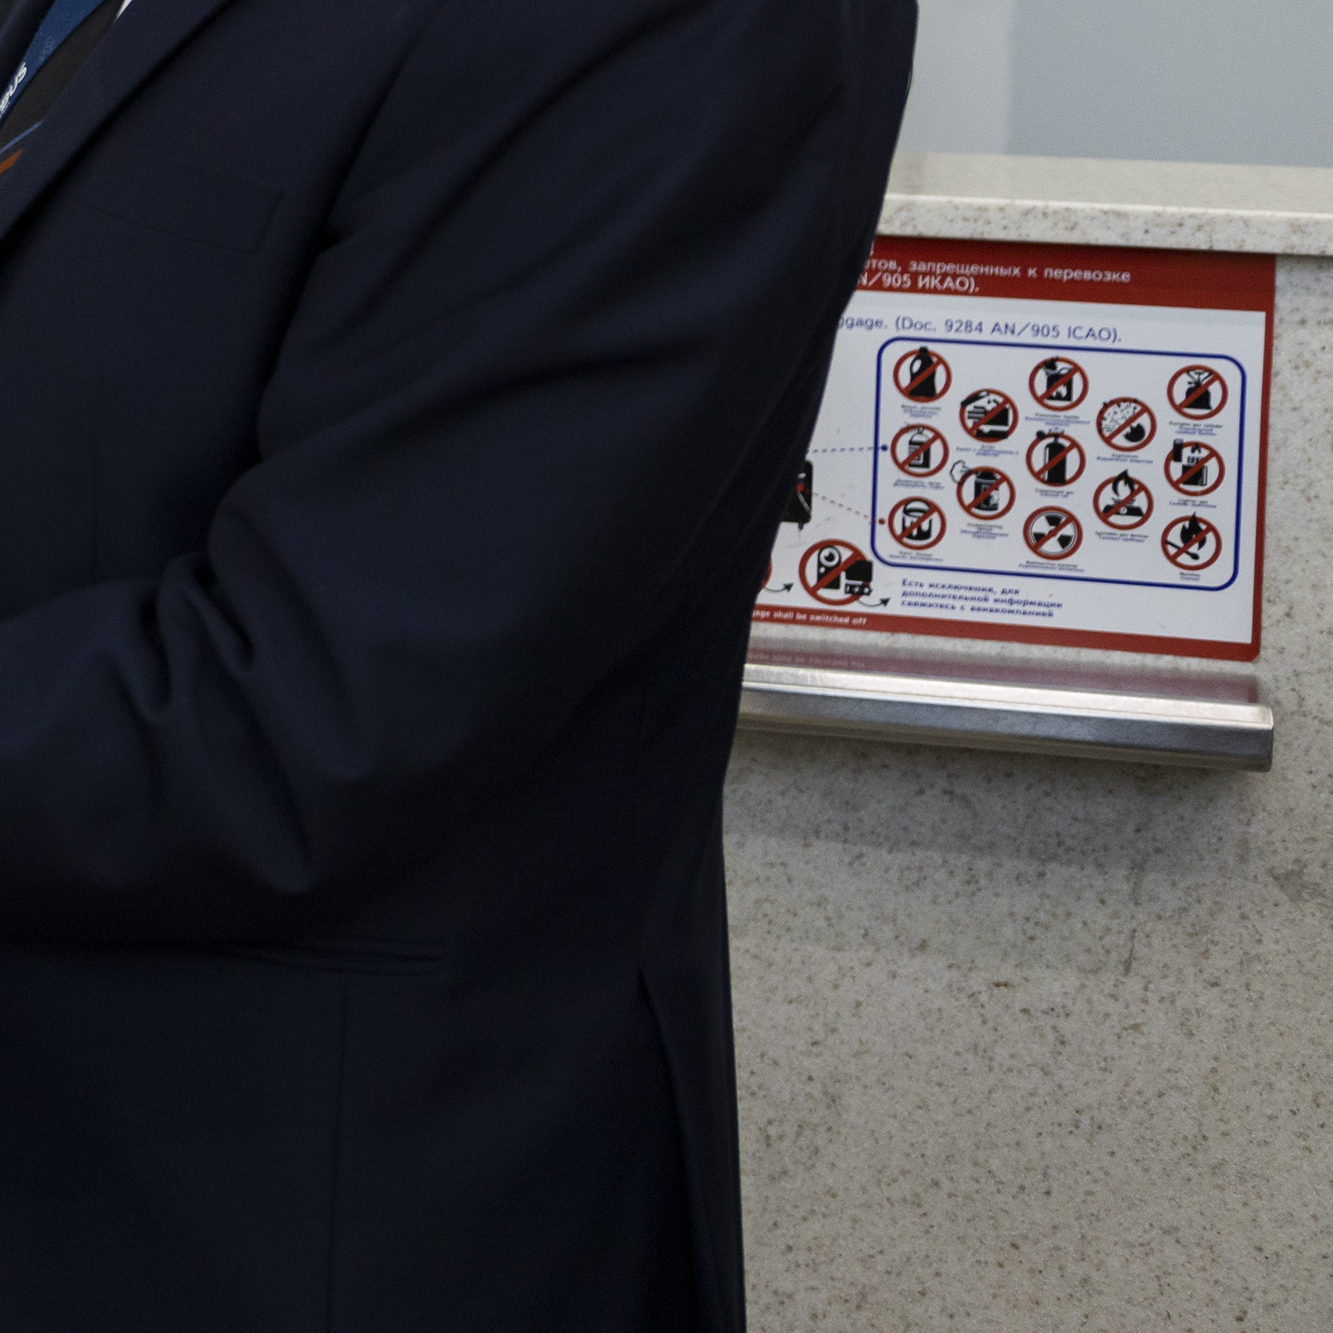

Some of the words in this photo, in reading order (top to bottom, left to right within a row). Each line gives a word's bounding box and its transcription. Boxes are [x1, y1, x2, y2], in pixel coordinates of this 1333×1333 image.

[908, 259, 1021, 278] запрещенных
[1027, 266, 1038, 278] к
[1043, 269, 1132, 284] перевозке
[857, 271, 911, 289] N/905
[917, 274, 980, 294] ИКАО).
[895, 315, 937, 333] (Doc.
[944, 318, 984, 334] 9284
[990, 321, 1061, 339] AN/905
[1066, 325, 1123, 344] ICAO).
[901, 578, 925, 588] Есть
[928, 581, 997, 595] исключения,
[1000, 587, 1021, 596] для
[901, 589, 990, 603] дополнительной
[993, 596, 1063, 609] информации
[901, 599, 957, 610] свяжитесь
[970, 604, 1054, 618] авиакомпанией
[773, 610, 794, 619] shall
[796, 612, 807, 620] be
[810, 613, 850, 624] switched
[852, 617, 868, 626] off
